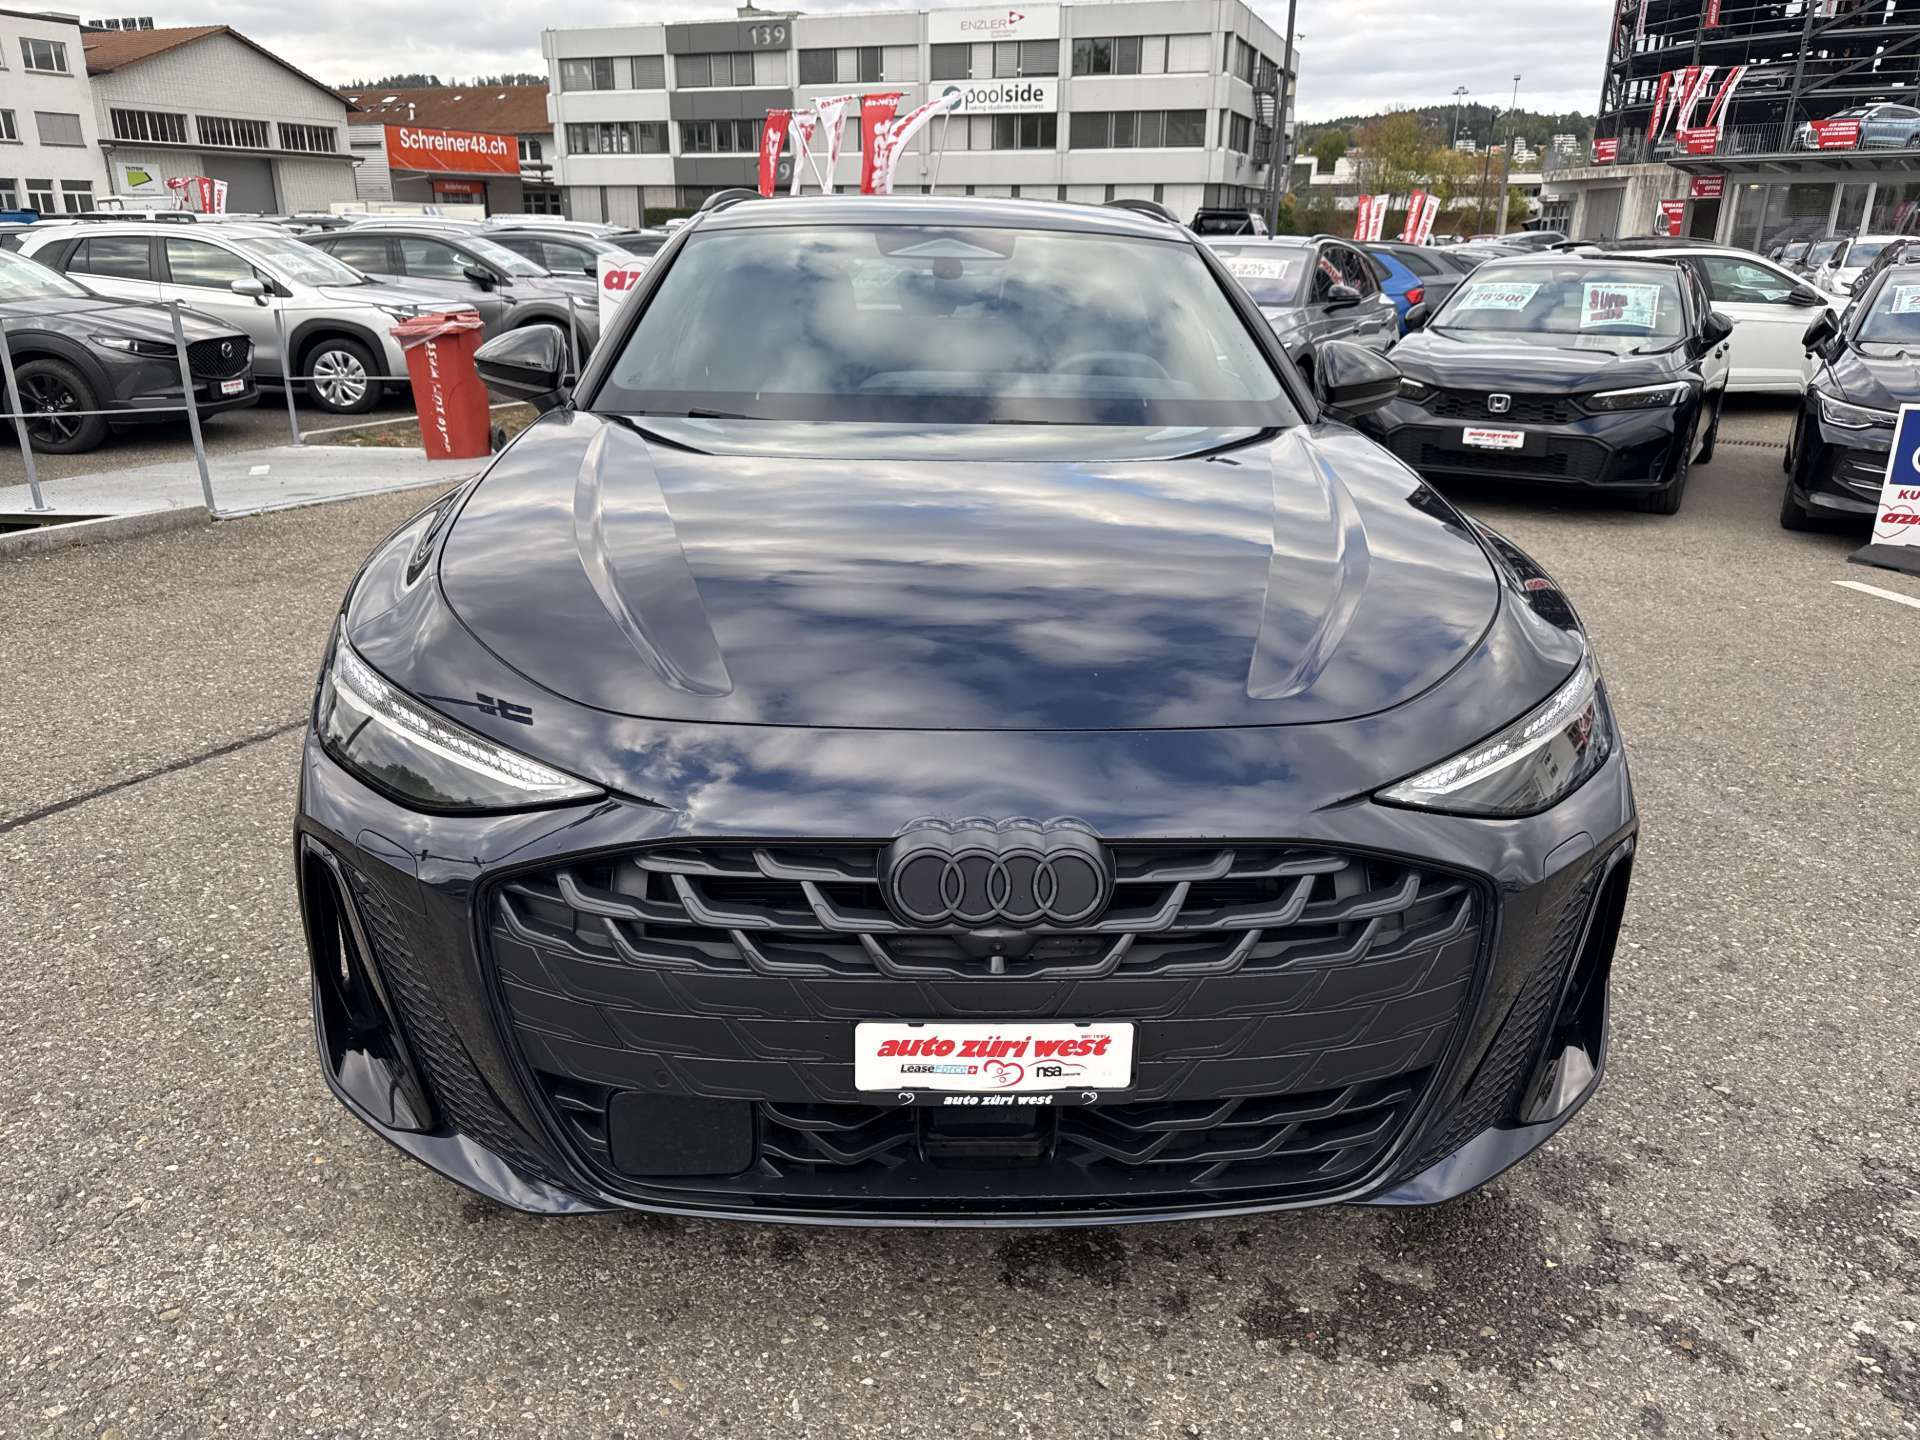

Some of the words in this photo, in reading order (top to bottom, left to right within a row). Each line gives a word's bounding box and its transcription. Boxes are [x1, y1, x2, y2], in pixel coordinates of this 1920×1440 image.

[960, 19, 1007, 31] ENZLER
[748, 24, 786, 46] 139
[965, 83, 1044, 111] poolside
[400, 128, 508, 155] Schreiner48.ch
[877, 1036, 956, 1057] auto
[956, 1036, 1032, 1057] züri
[1035, 1036, 1112, 1056] west
[900, 1064, 967, 1074] LeaseForce
[1036, 1066, 1062, 1077] nsa
[943, 1095, 979, 1105] auto
[981, 1094, 1015, 1105] züri
[1018, 1095, 1053, 1105] west
